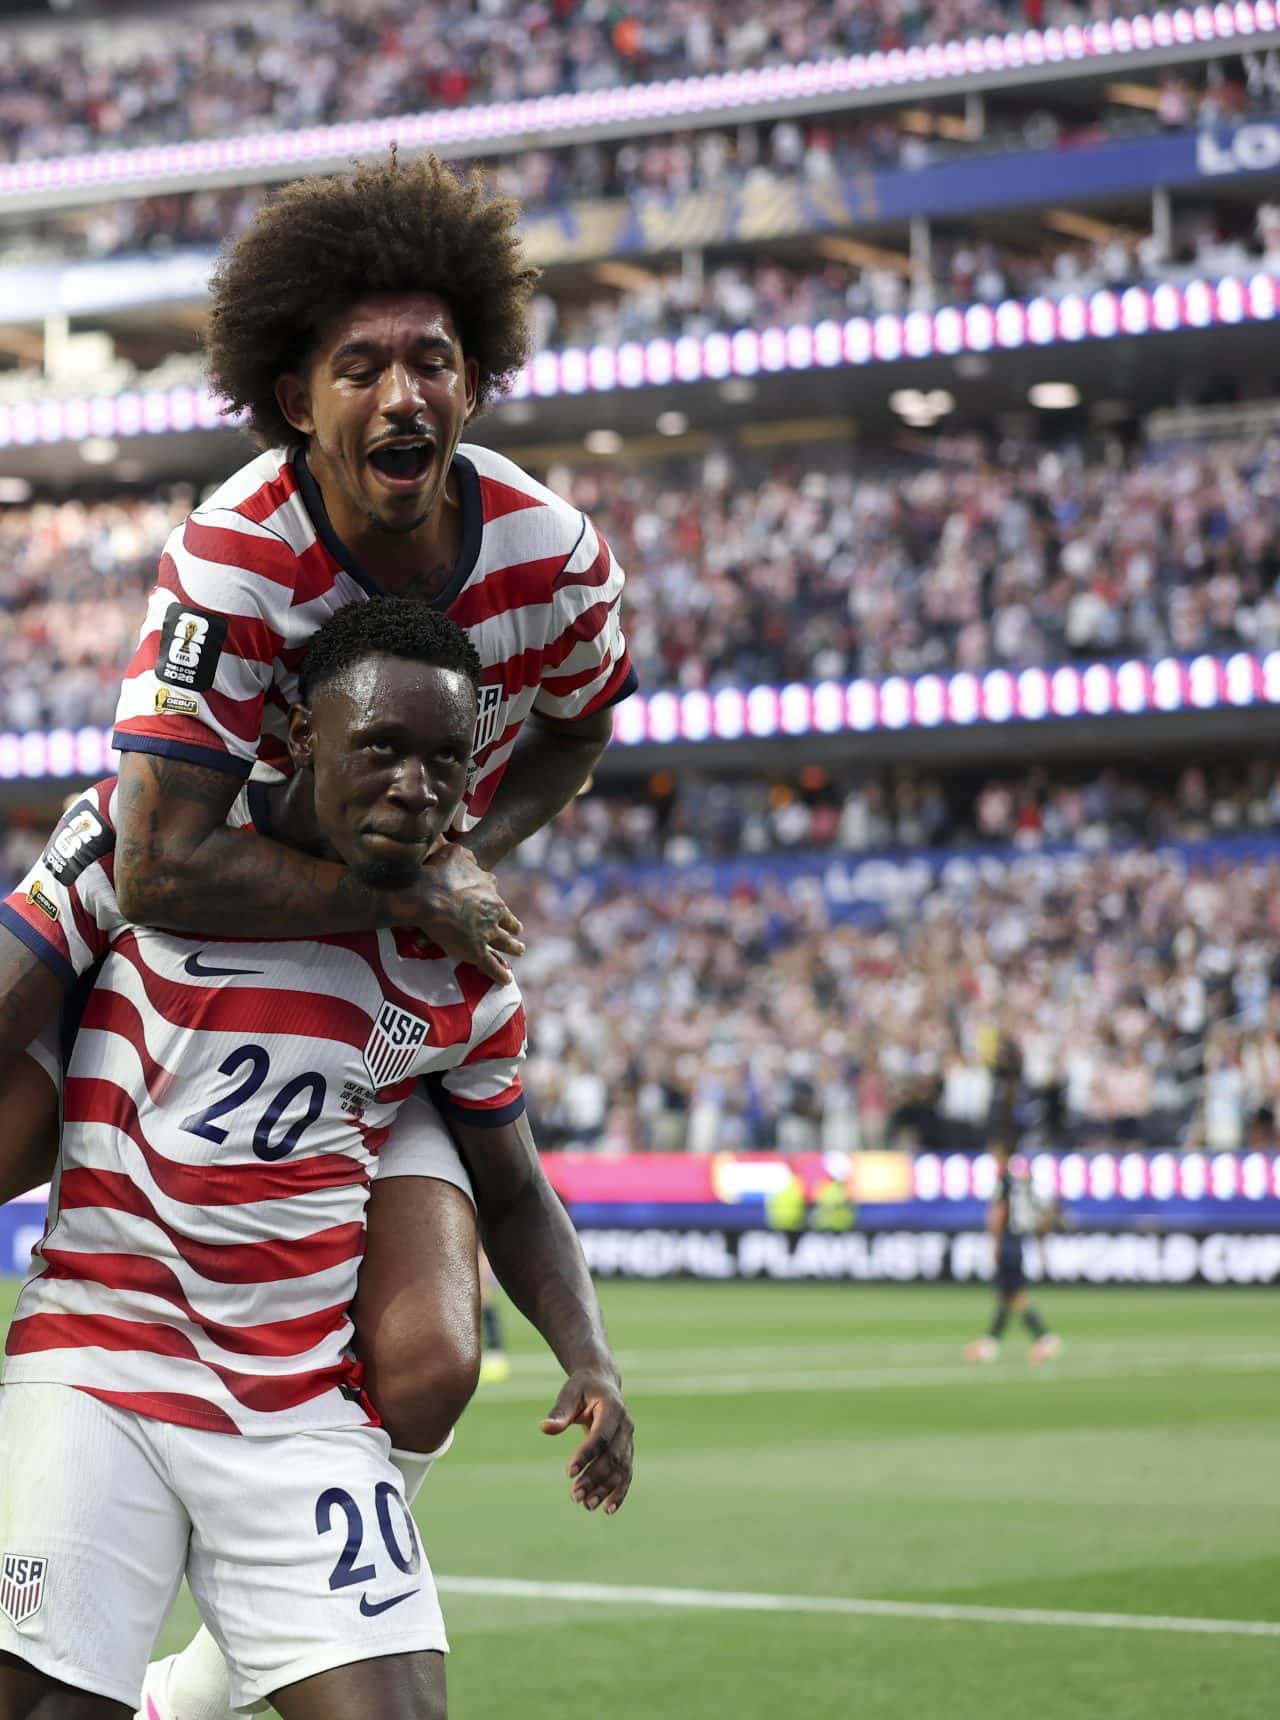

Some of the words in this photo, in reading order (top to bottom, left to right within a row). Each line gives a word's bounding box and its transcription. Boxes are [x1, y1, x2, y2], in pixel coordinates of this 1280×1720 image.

[166, 662, 184, 673] WORLD
[184, 667, 197, 676] CUP
[175, 653, 190, 663] FIFA
[163, 668, 195, 684] 2026
[166, 697, 196, 708] DEBUT
[36, 891, 57, 913] DEBUT
[380, 1005, 426, 1045] USA
[178, 1044, 327, 1162] 20
[737, 1231, 946, 1280] PLAYLIST
[315, 1481, 421, 1591] 20
[5, 1557, 43, 1584] USA
